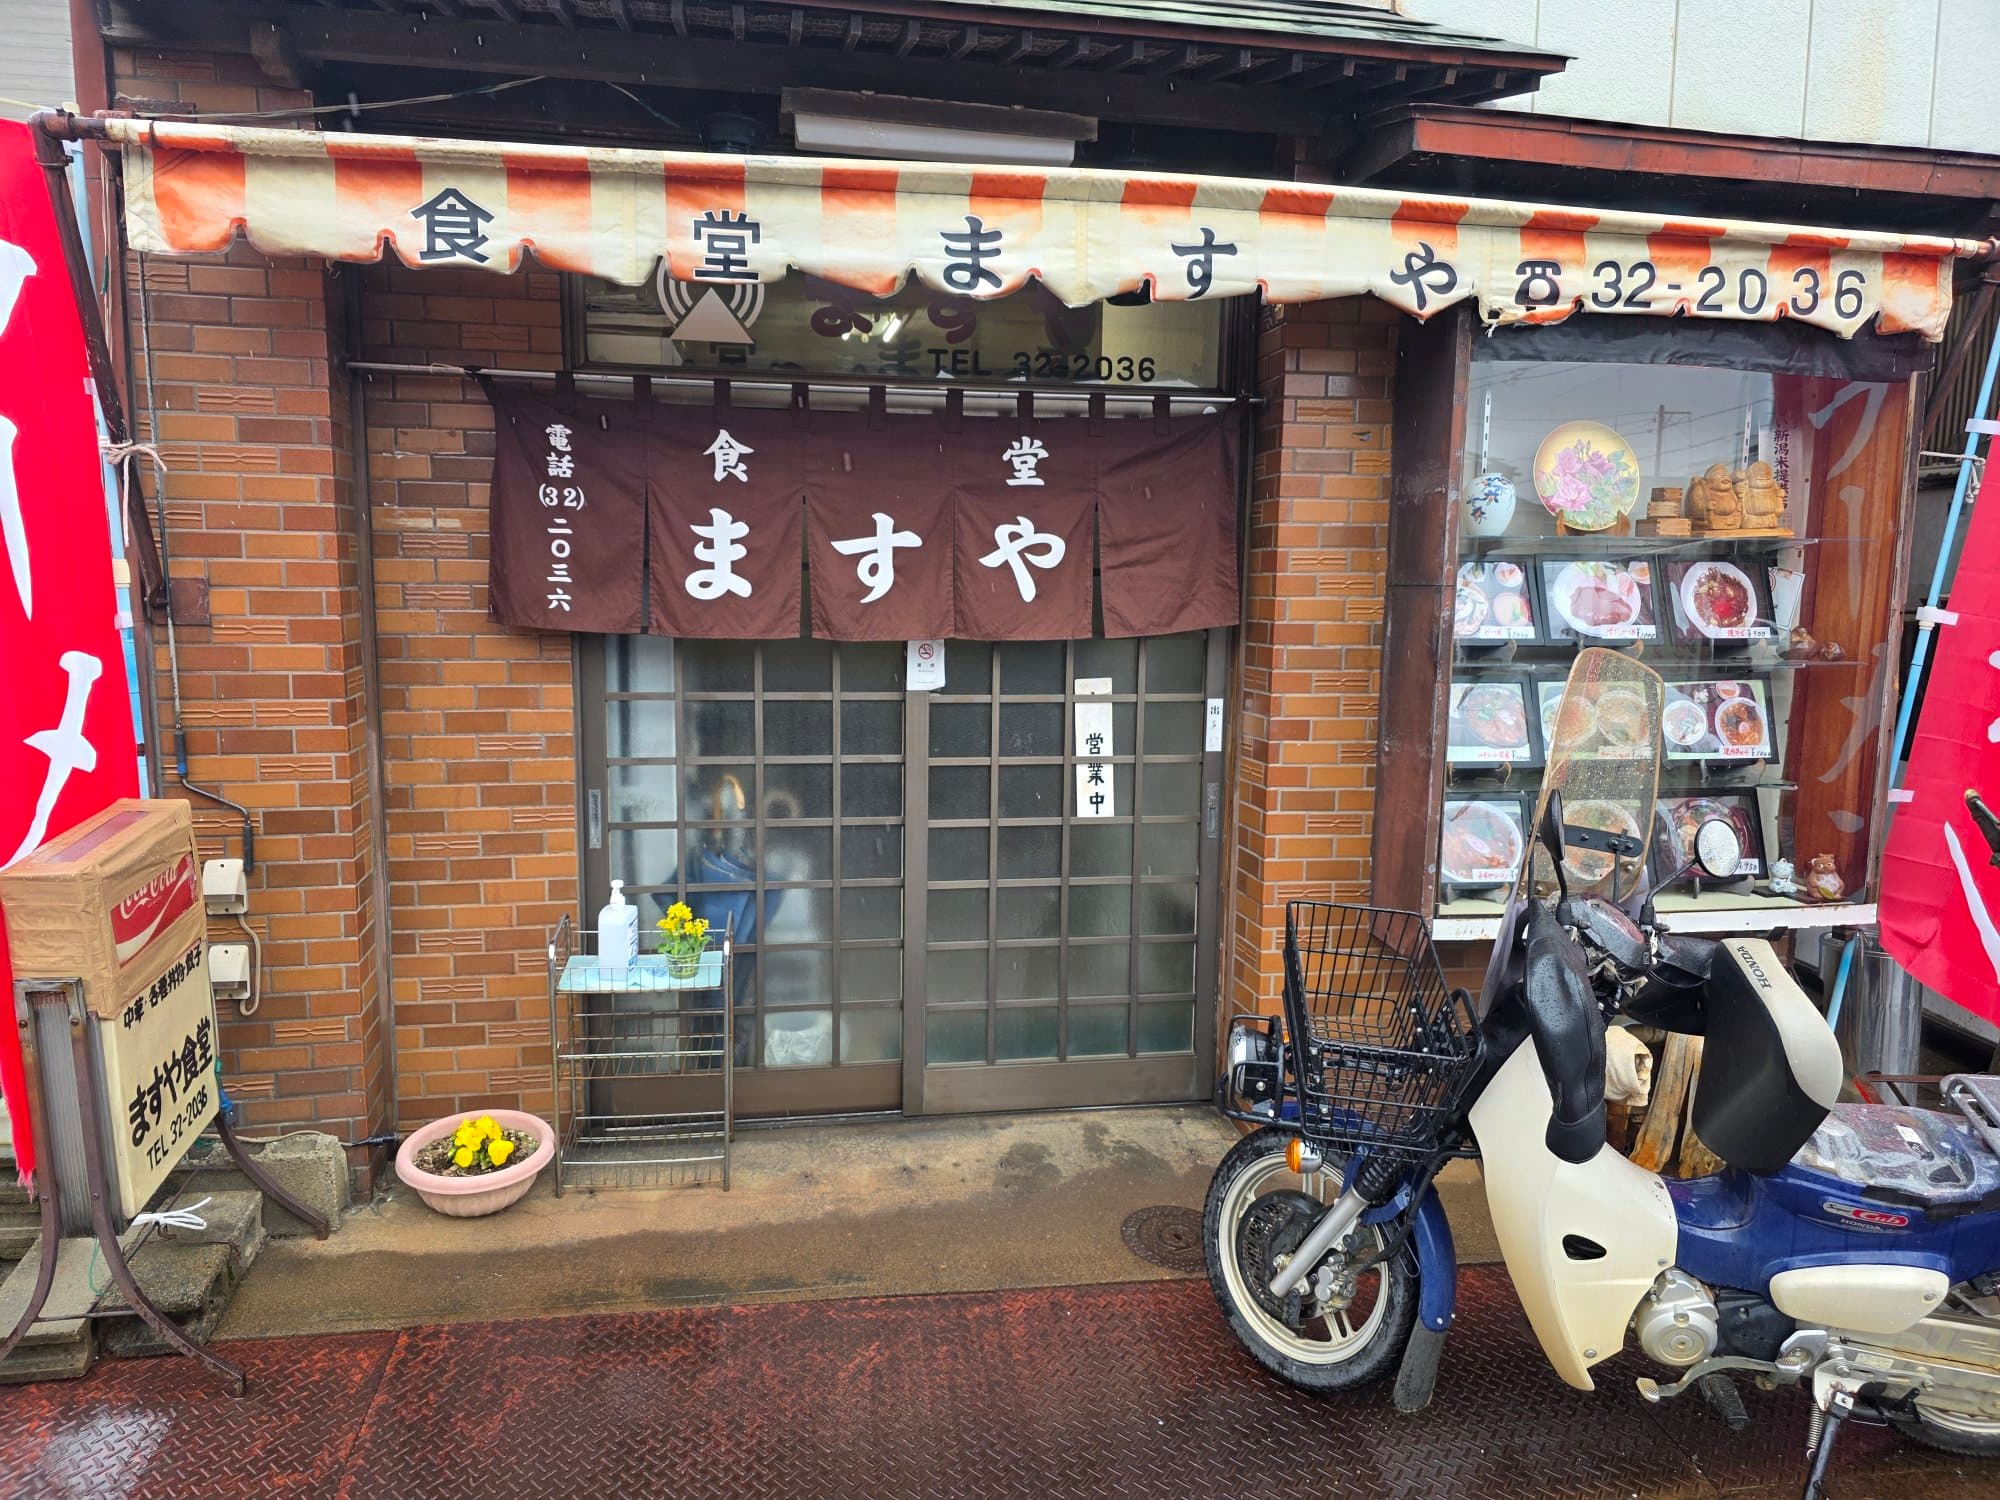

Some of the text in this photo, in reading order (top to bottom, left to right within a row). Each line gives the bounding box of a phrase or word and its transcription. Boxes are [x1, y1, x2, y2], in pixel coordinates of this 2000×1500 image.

[1591, 259, 1867, 321] 32-2036
[927, 348, 992, 376] TEL
[703, 429, 1050, 486] 食堂
[1774, 429, 1790, 509] 新潟米提
[685, 508, 1067, 604] ますや
[1085, 732, 1105, 815] 営業中
[1737, 945, 1773, 989] HONDA
[128, 1015, 212, 1147] ますや食堂
[146, 1134, 169, 1172] TEL
[1840, 1218, 1881, 1231] HONDA
[1859, 1211, 1901, 1224] Cub
